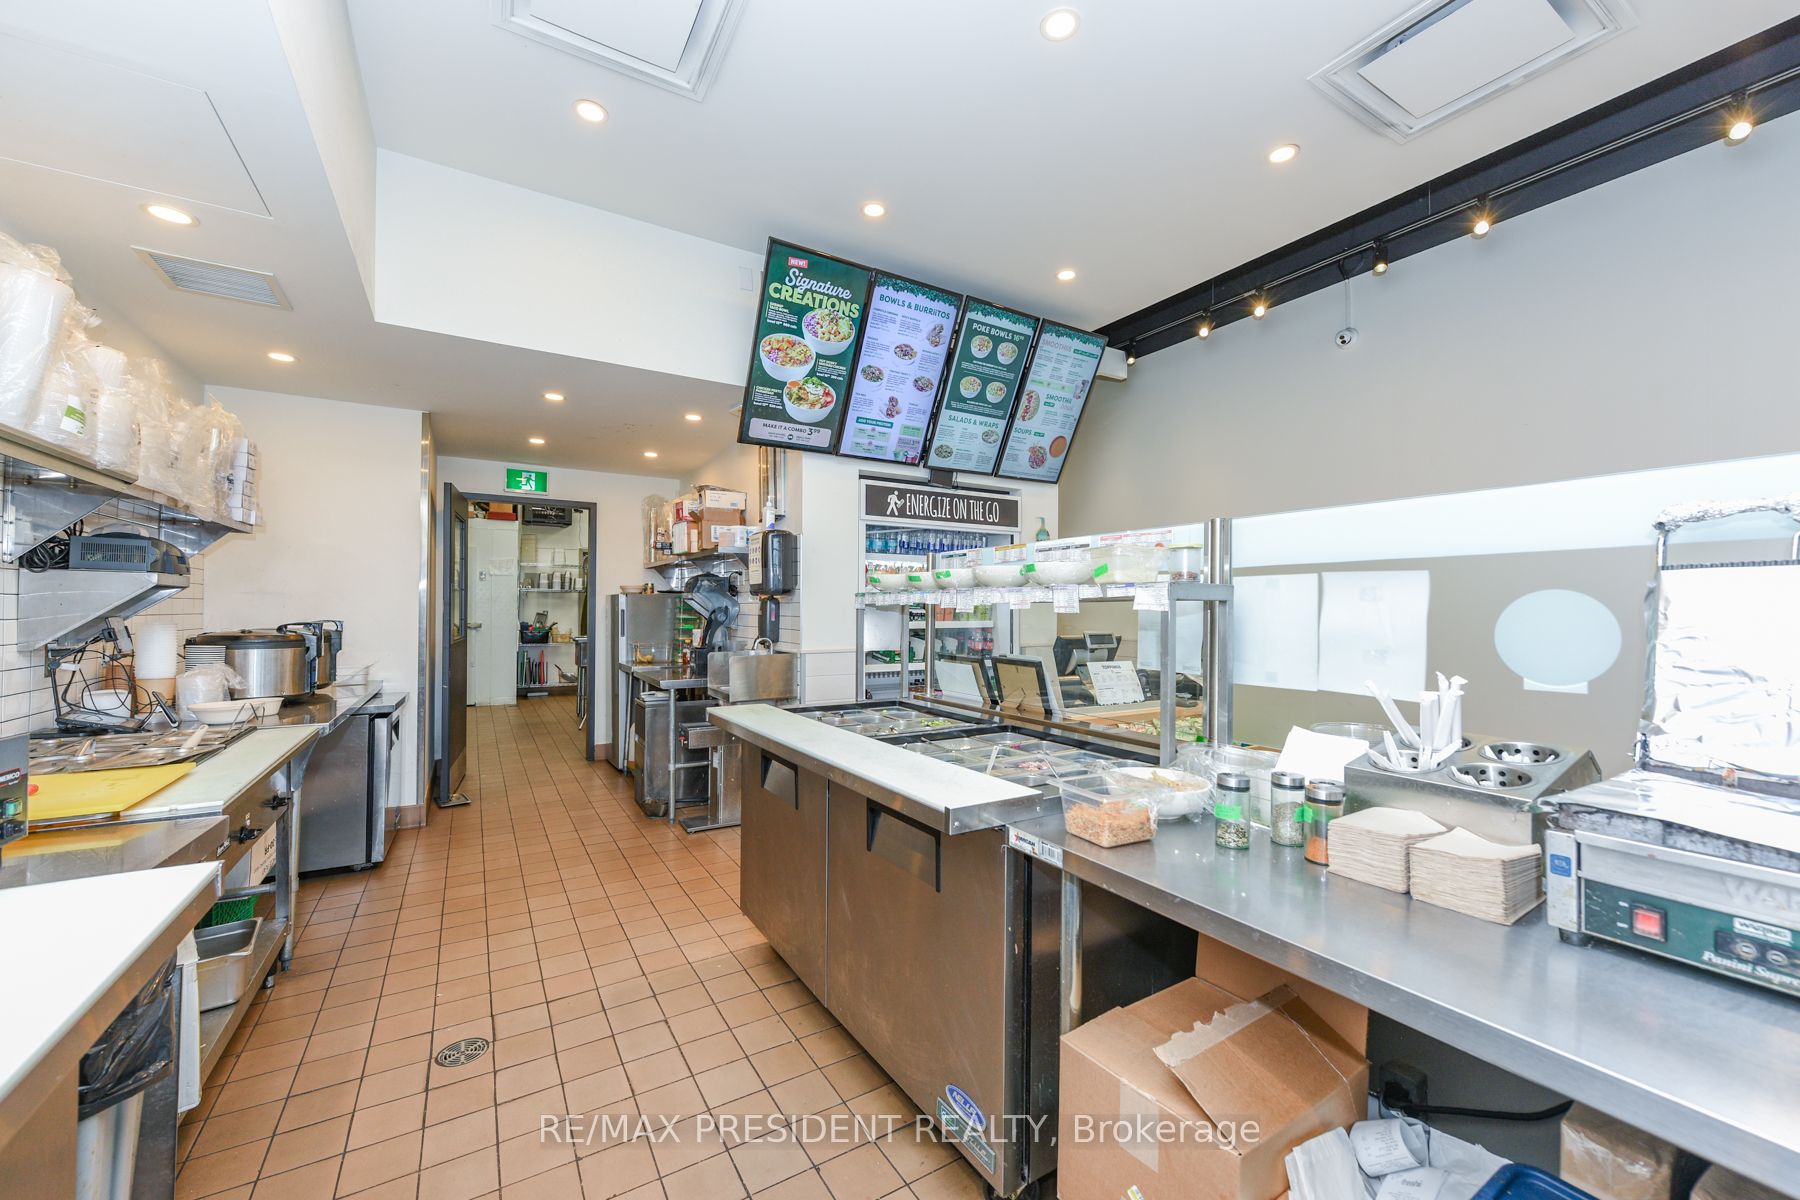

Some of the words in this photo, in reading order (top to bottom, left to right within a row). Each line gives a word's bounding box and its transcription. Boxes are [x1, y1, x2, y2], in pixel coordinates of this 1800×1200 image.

[790, 259, 806, 267] NEW!
[785, 267, 852, 300] Signature
[768, 282, 860, 319] CREATIONS
[879, 293, 906, 308] BOWLS
[906, 301, 913, 310] &
[972, 322, 990, 335] POKE
[990, 327, 1012, 340] BOWLS
[762, 422, 778, 430] MAKE
[787, 426, 807, 434] COMBO
[948, 414, 972, 425] SALADS
[978, 420, 999, 429] WRAPS
[1013, 426, 1033, 436] SOUPS
[906, 493, 951, 518] ENERGIZE
[952, 498, 967, 520] ON
[969, 499, 984, 522] THE
[985, 501, 999, 523] GO
